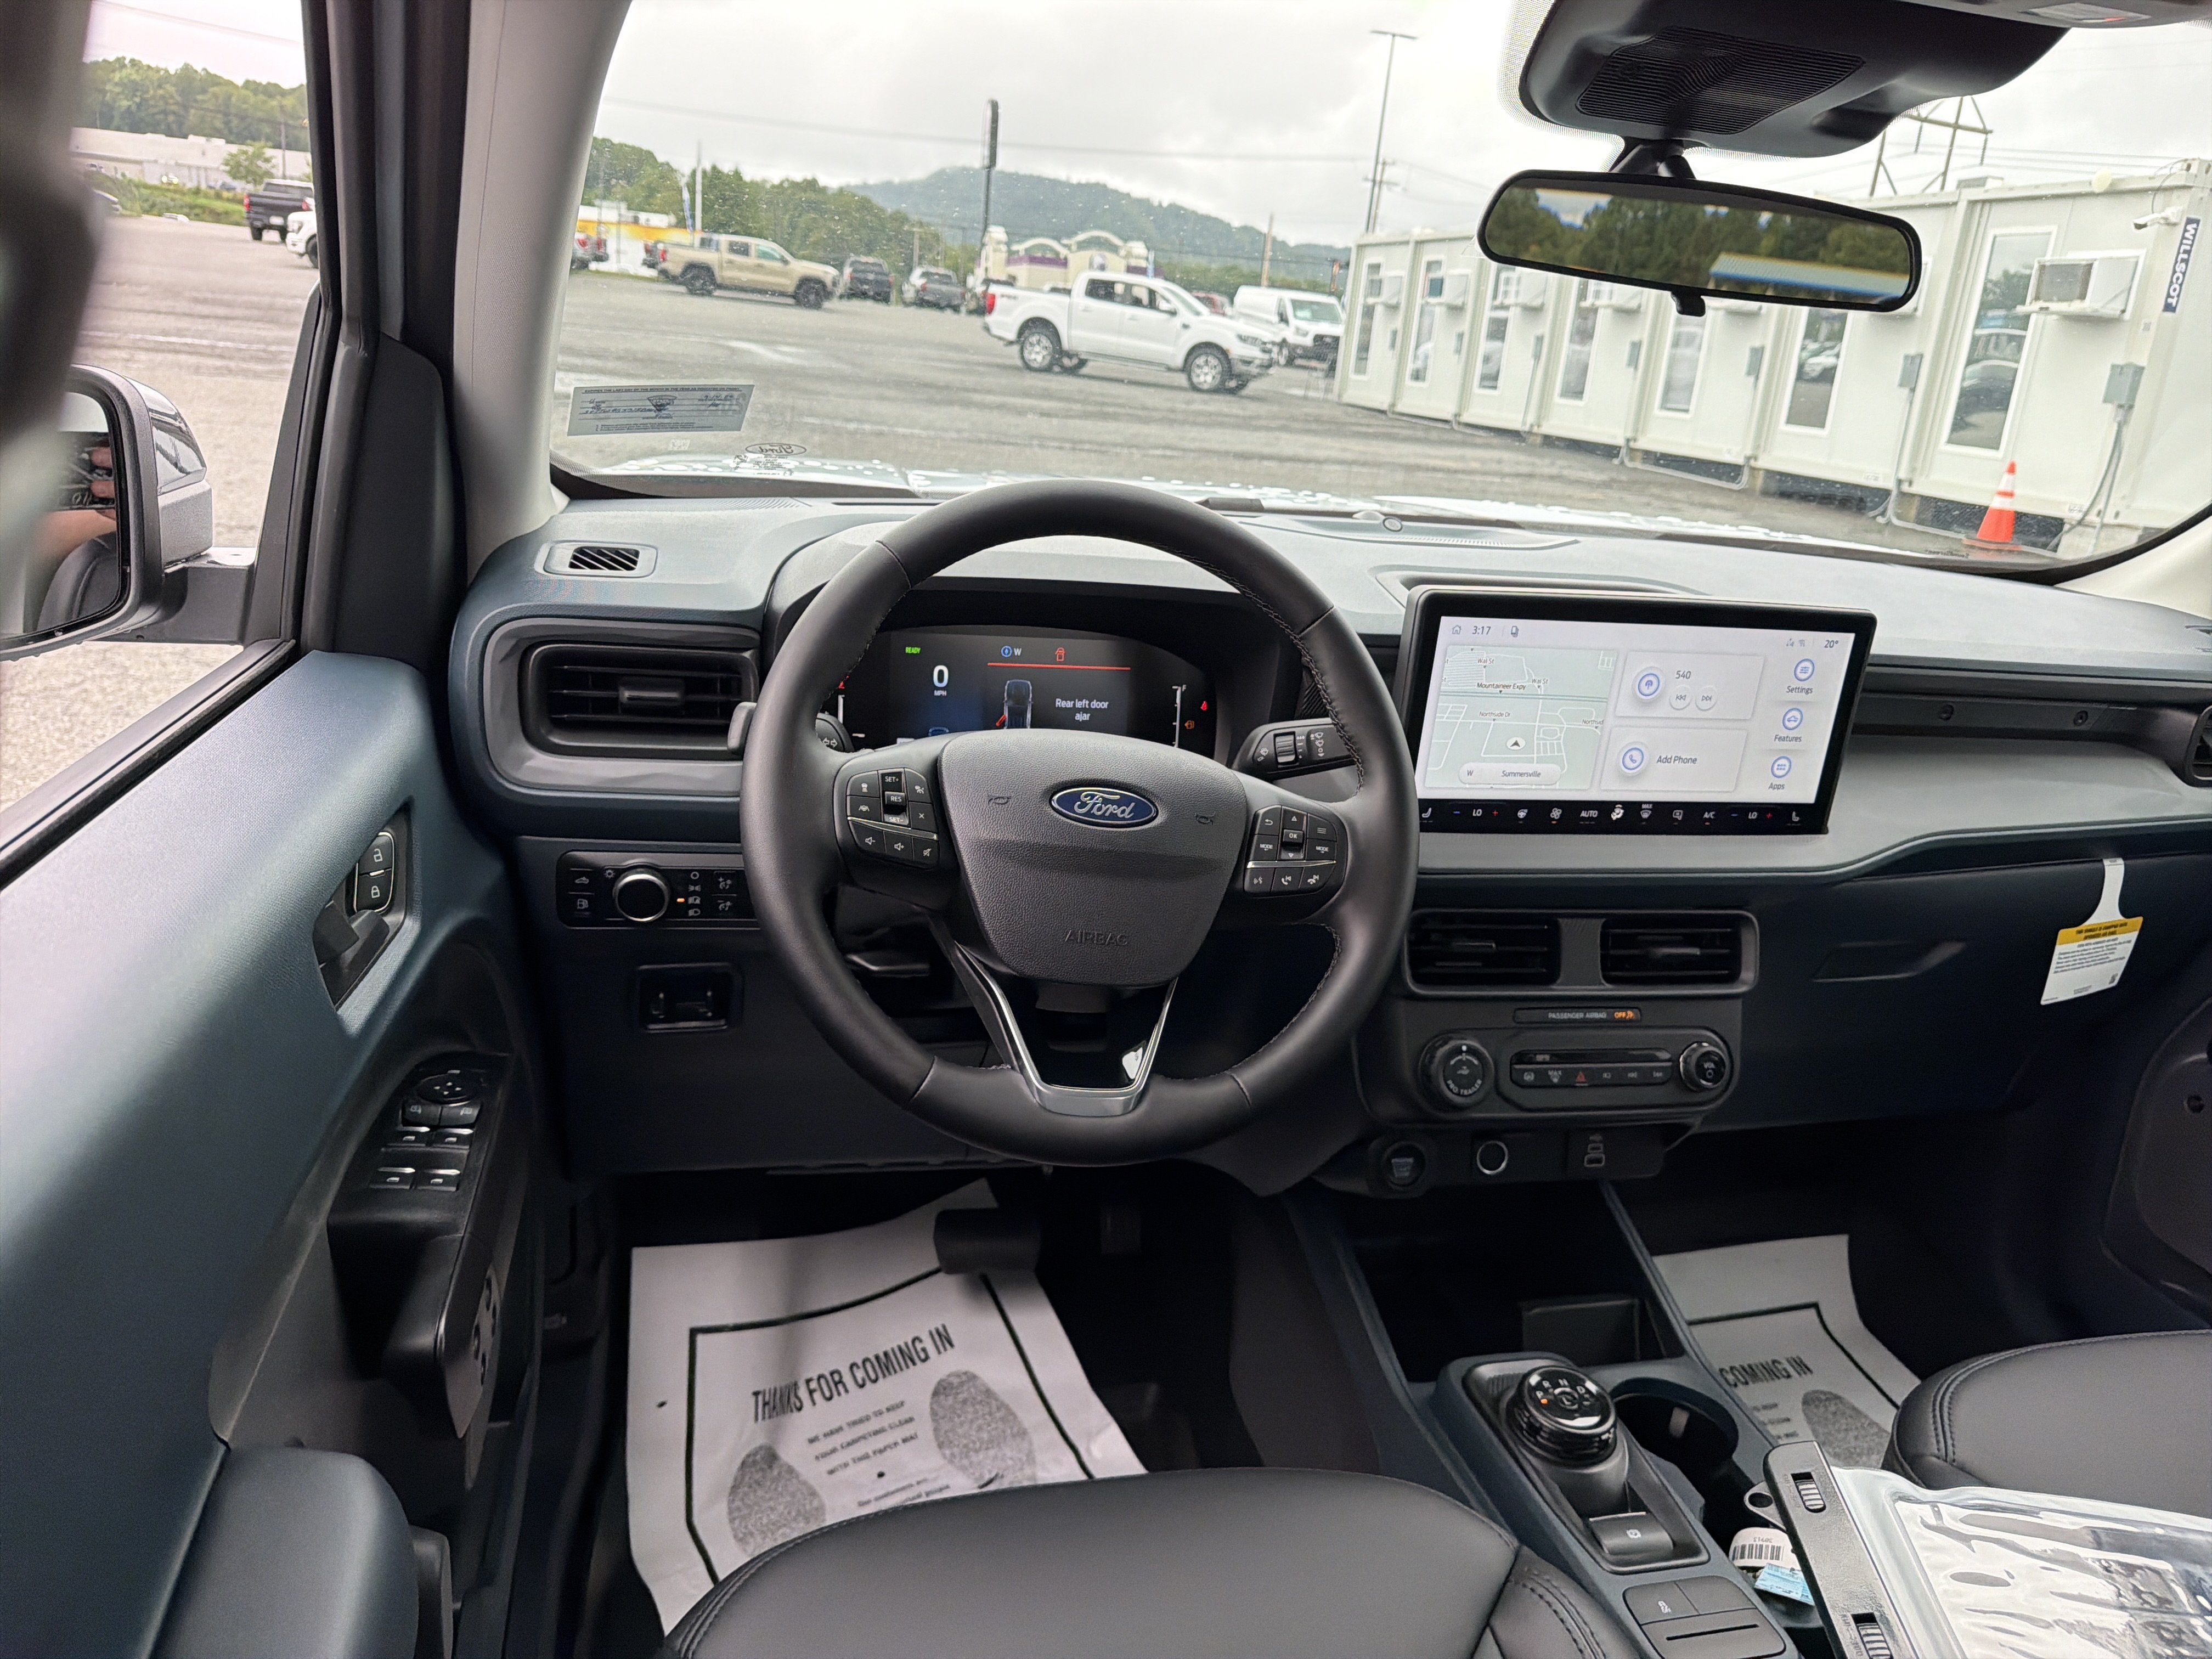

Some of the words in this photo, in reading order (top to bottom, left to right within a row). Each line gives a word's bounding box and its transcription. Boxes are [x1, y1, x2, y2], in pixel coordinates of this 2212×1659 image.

[2167, 223, 2197, 307] WILLSCOT
[1472, 625, 1491, 635] 3:17
[1824, 639, 1839, 648] 20°
[1013, 647, 1022, 656] W
[933, 664, 949, 688] 0
[1675, 670, 1691, 679] 540
[1513, 682, 1526, 691] Expy
[1786, 685, 1813, 695] Settings
[1055, 698, 1073, 708] Rear
[1075, 698, 1089, 708] left
[1090, 699, 1109, 709] door
[1074, 712, 1091, 722] ajar
[1774, 734, 1802, 743] Features
[1656, 755, 1672, 764] Add
[1673, 755, 1697, 765] Phone
[1501, 770, 1541, 778] Summersville
[1768, 782, 1785, 791] Apps
[1074, 791, 1136, 820] Ford
[1472, 809, 1482, 817] LO
[1703, 811, 1716, 819] A/C
[1064, 928, 1129, 946] AIRBAG
[1460, 1079, 1482, 1096] TRAILER
[752, 1380, 804, 1424] THANKS
[805, 1368, 849, 1407] FOR
[849, 1335, 931, 1389] COMING
[929, 1323, 955, 1355] IN
[1718, 1358, 1792, 1388] COMING
[1785, 1355, 1814, 1377] IN
[1576, 1385, 1586, 1394] D
